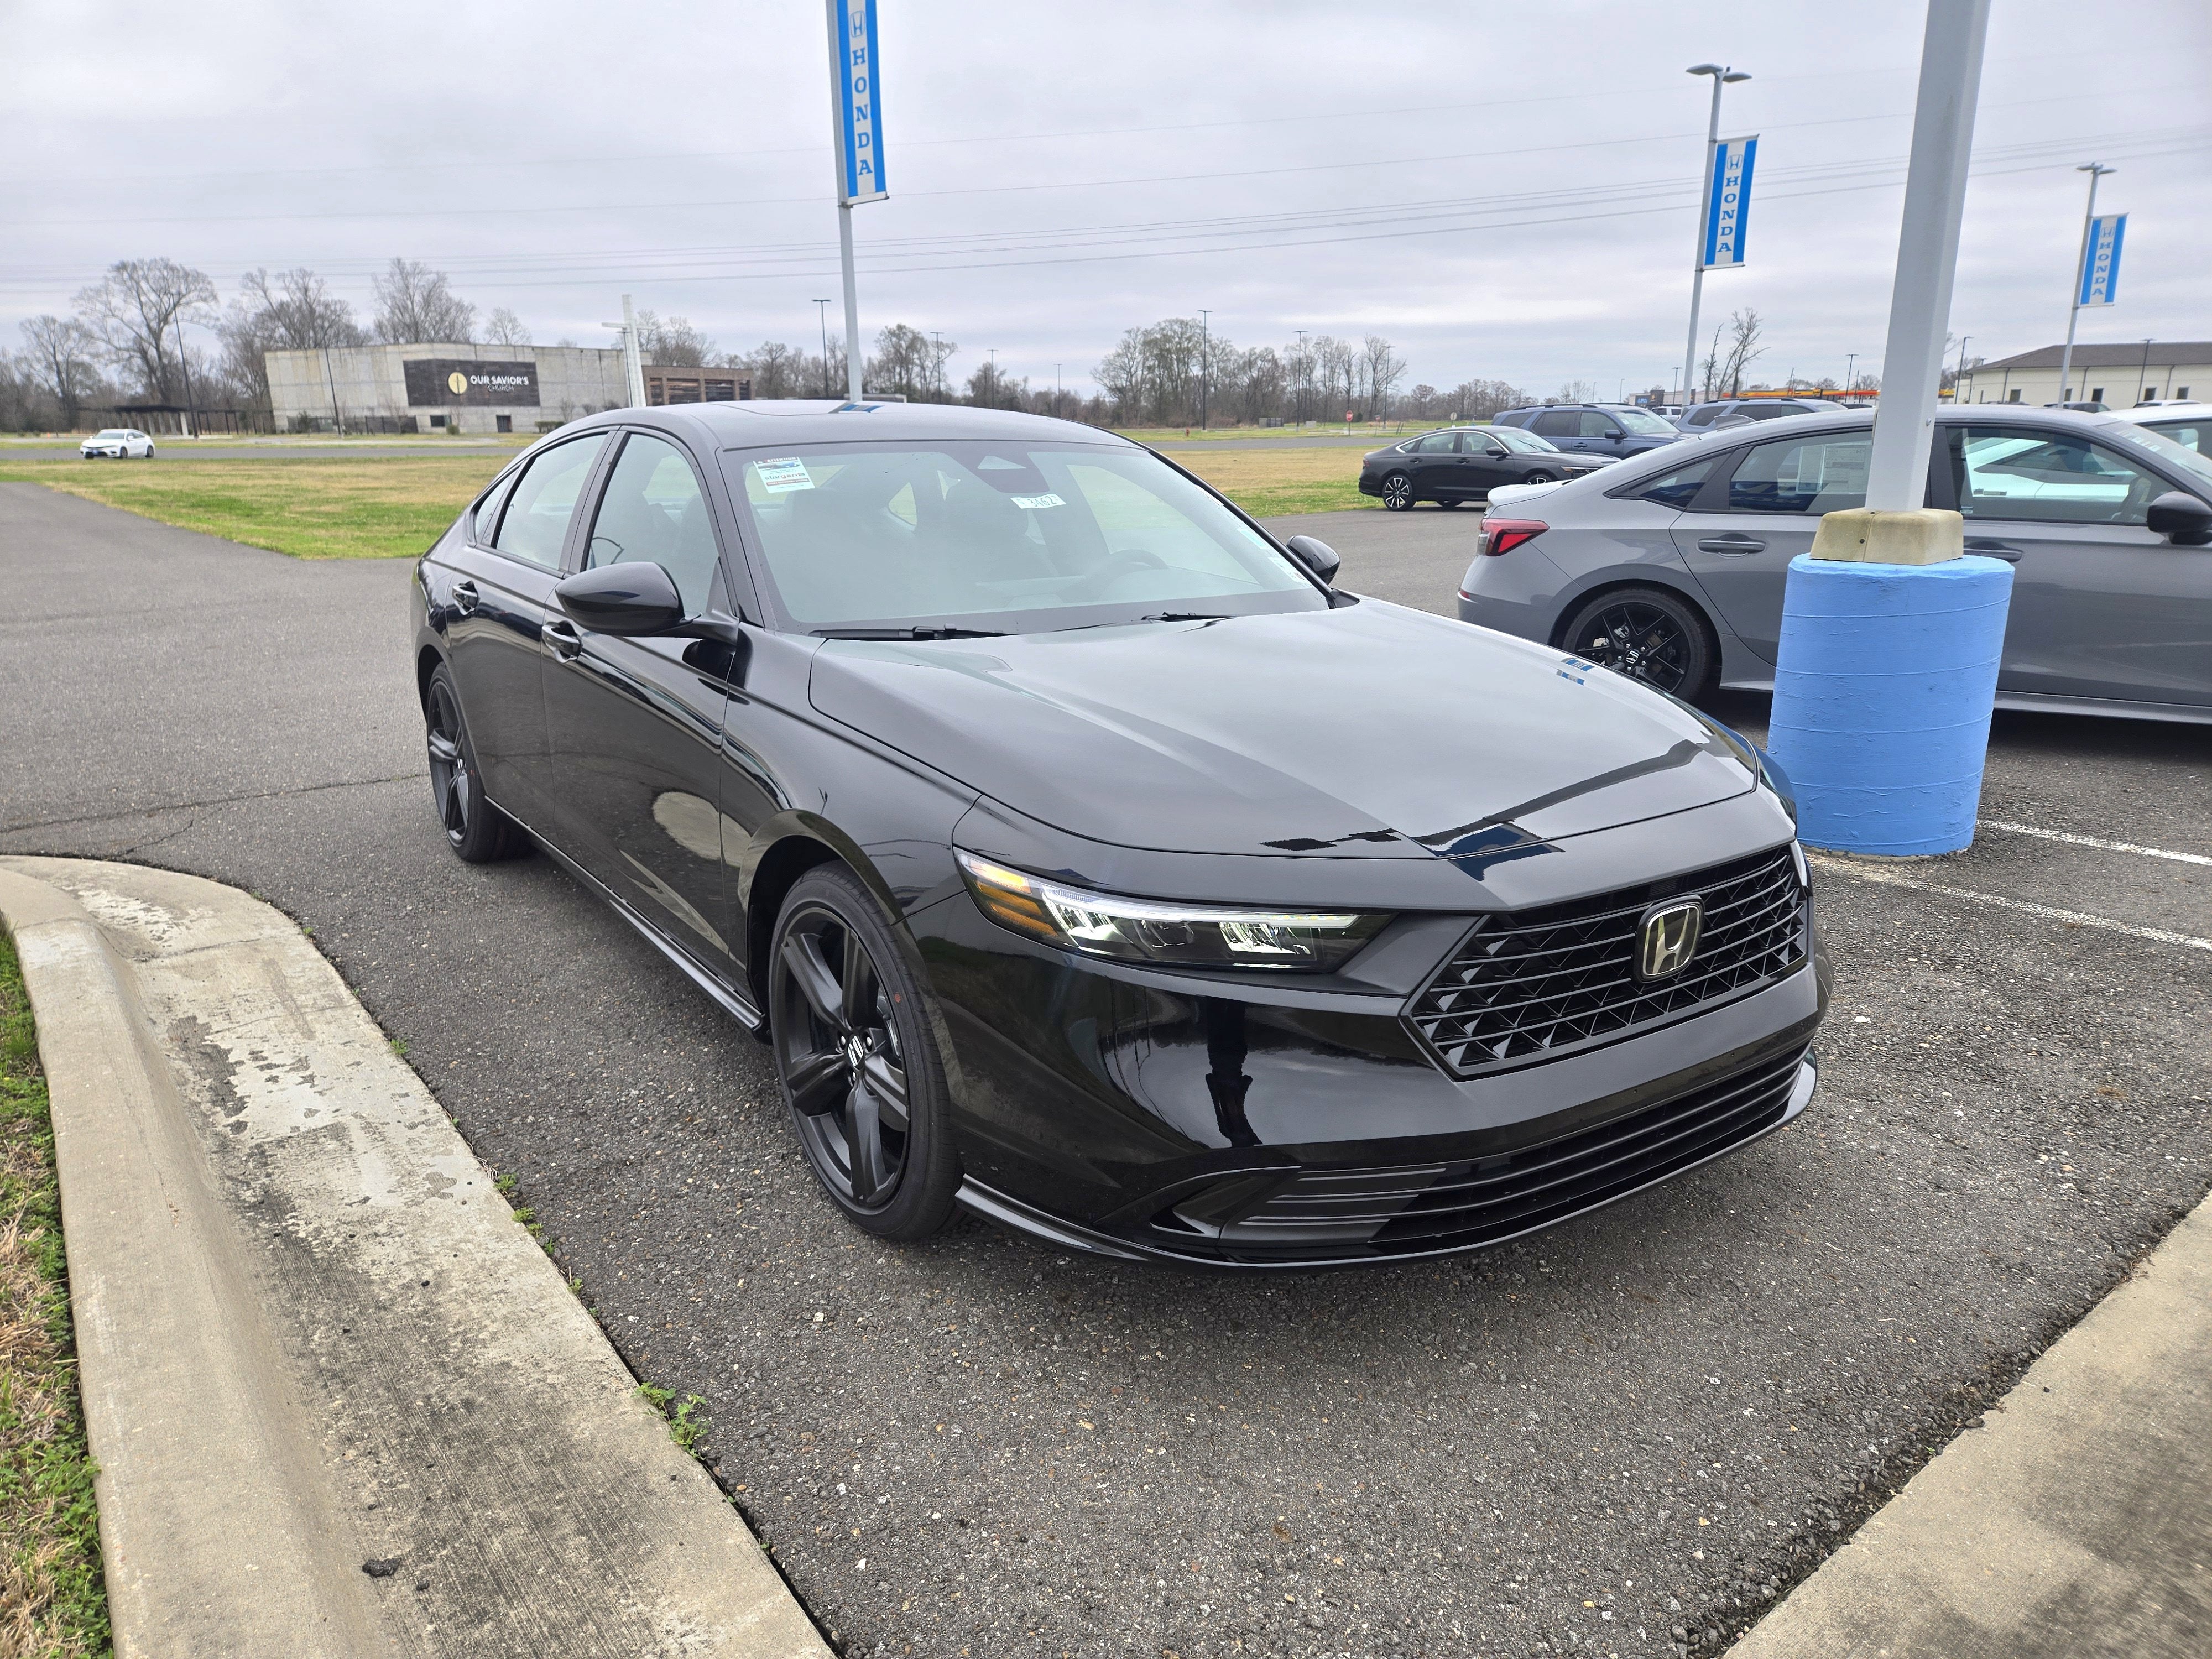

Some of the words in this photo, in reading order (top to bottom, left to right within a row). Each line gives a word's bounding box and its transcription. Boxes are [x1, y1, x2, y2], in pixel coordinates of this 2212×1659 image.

[852, 48, 873, 175] HONDA
[1717, 176, 1740, 252] HONDA
[2092, 242, 2112, 295] HONDA
[470, 375, 490, 385] OUR
[491, 375, 529, 385] SAVIOR'S
[1027, 496, 1057, 507] 3462
